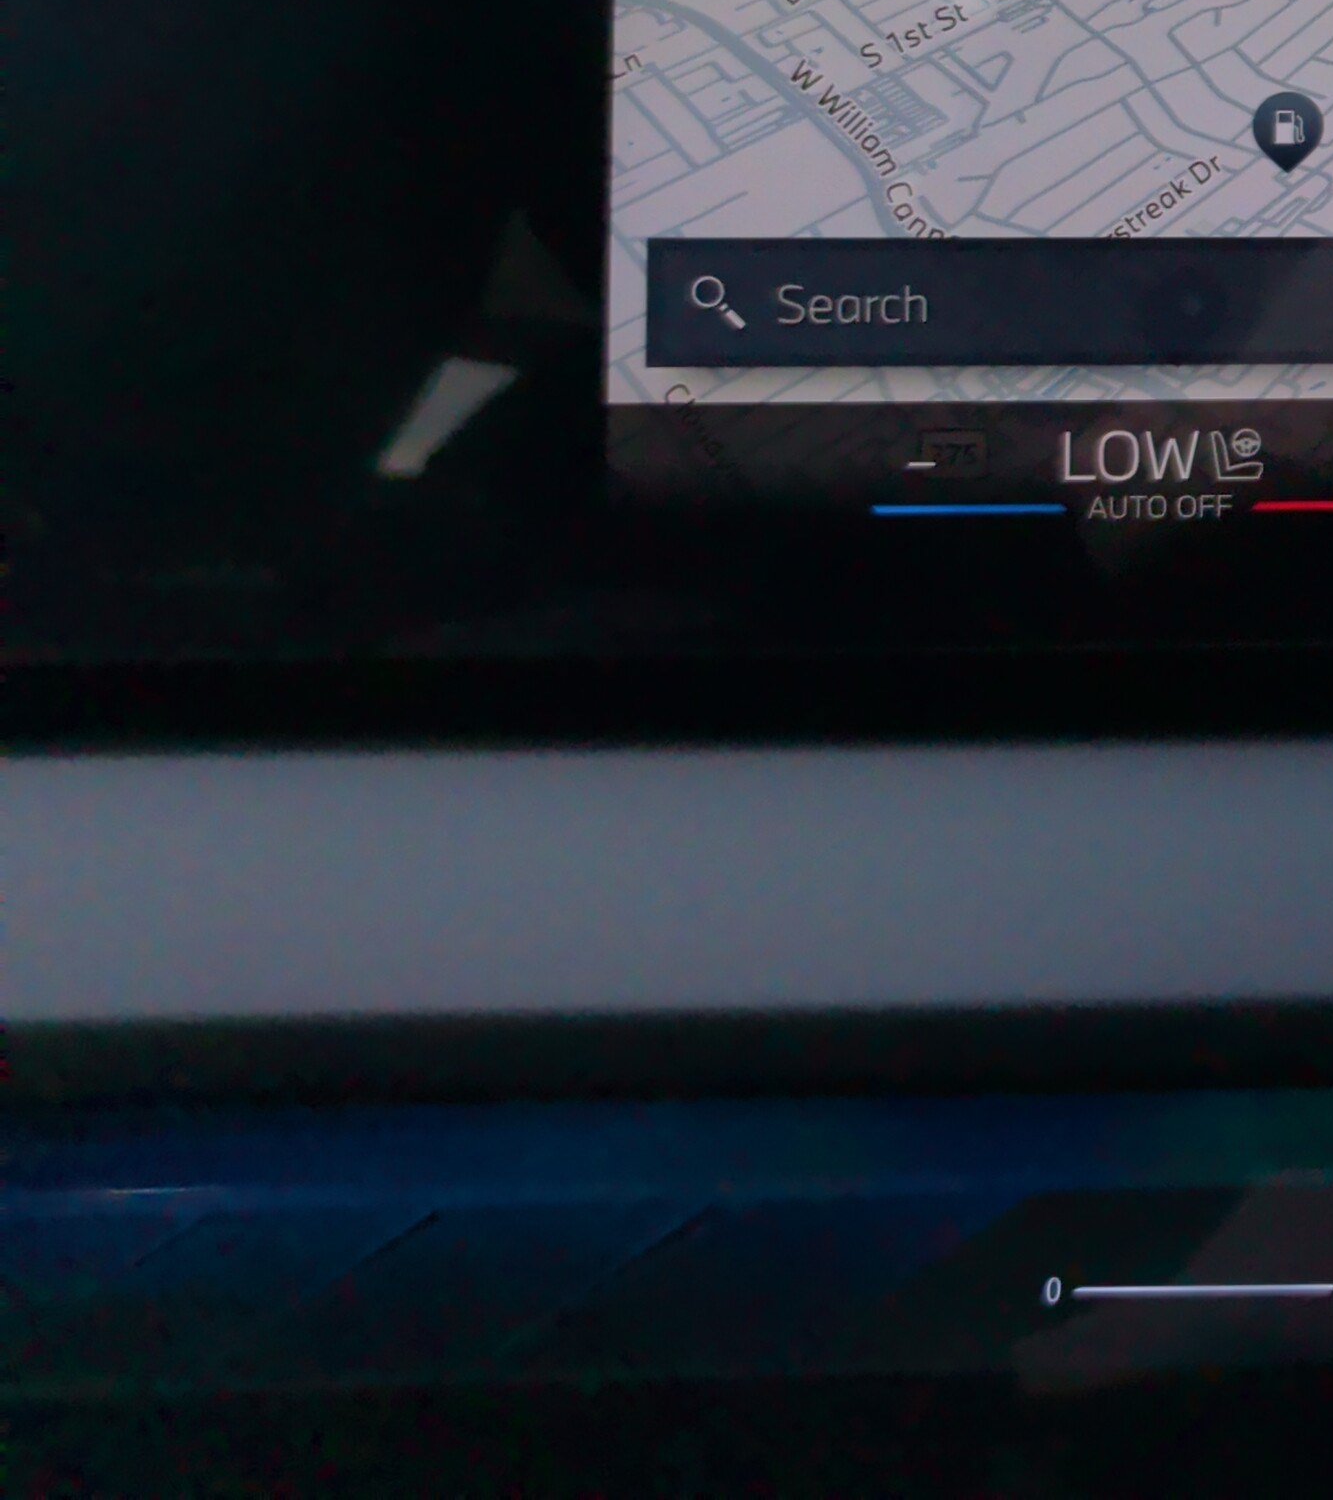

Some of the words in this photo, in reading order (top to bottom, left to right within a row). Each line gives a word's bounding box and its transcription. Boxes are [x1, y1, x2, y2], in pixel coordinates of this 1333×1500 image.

[859, 41, 884, 69] S
[887, 21, 932, 56] 1st
[934, 2, 969, 33] St
[788, 59, 820, 93] W
[818, 81, 897, 181] William
[1188, 155, 1222, 186] Dr
[777, 284, 929, 327] Search
[1061, 429, 1200, 484] LOW
[1088, 494, 1169, 520] AUTO
[1177, 494, 1233, 519] OFF
[1042, 1275, 1062, 1305] 0
